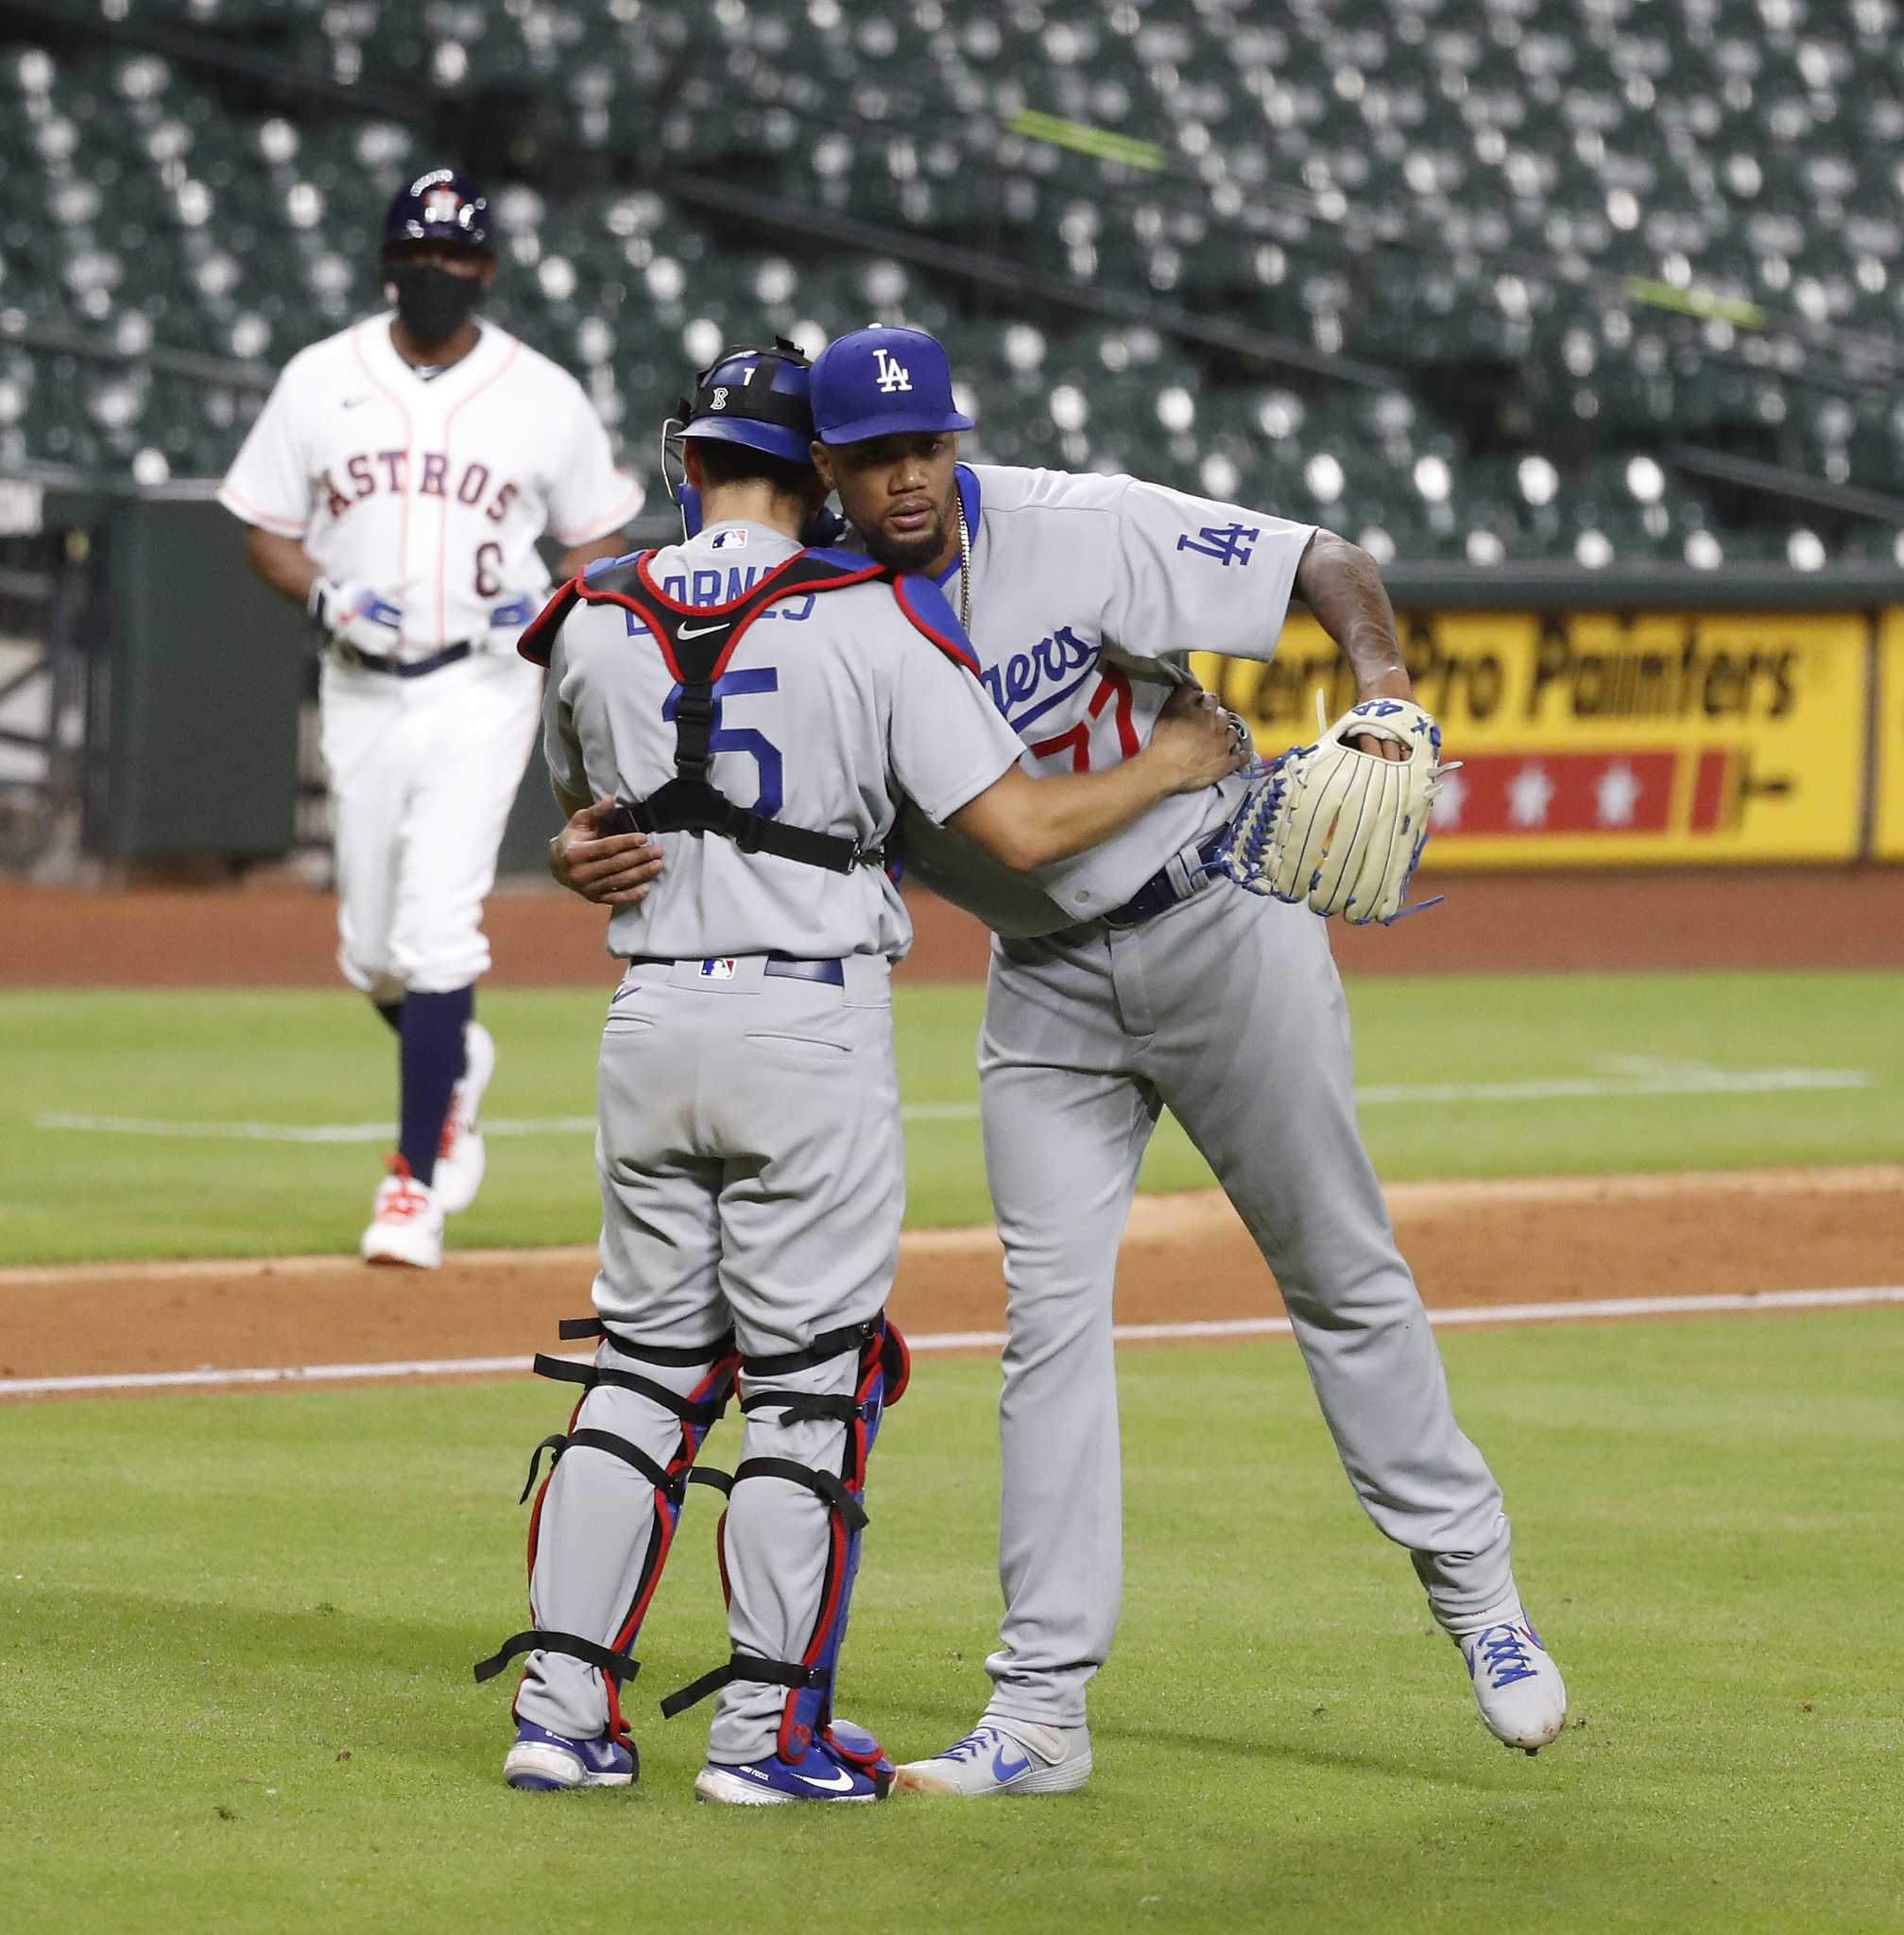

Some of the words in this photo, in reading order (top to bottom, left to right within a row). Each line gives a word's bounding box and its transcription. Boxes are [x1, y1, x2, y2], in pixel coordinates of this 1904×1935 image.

[872, 349, 913, 392] LA
[320, 449, 519, 523] ASTROS
[1176, 522, 1260, 566] LA
